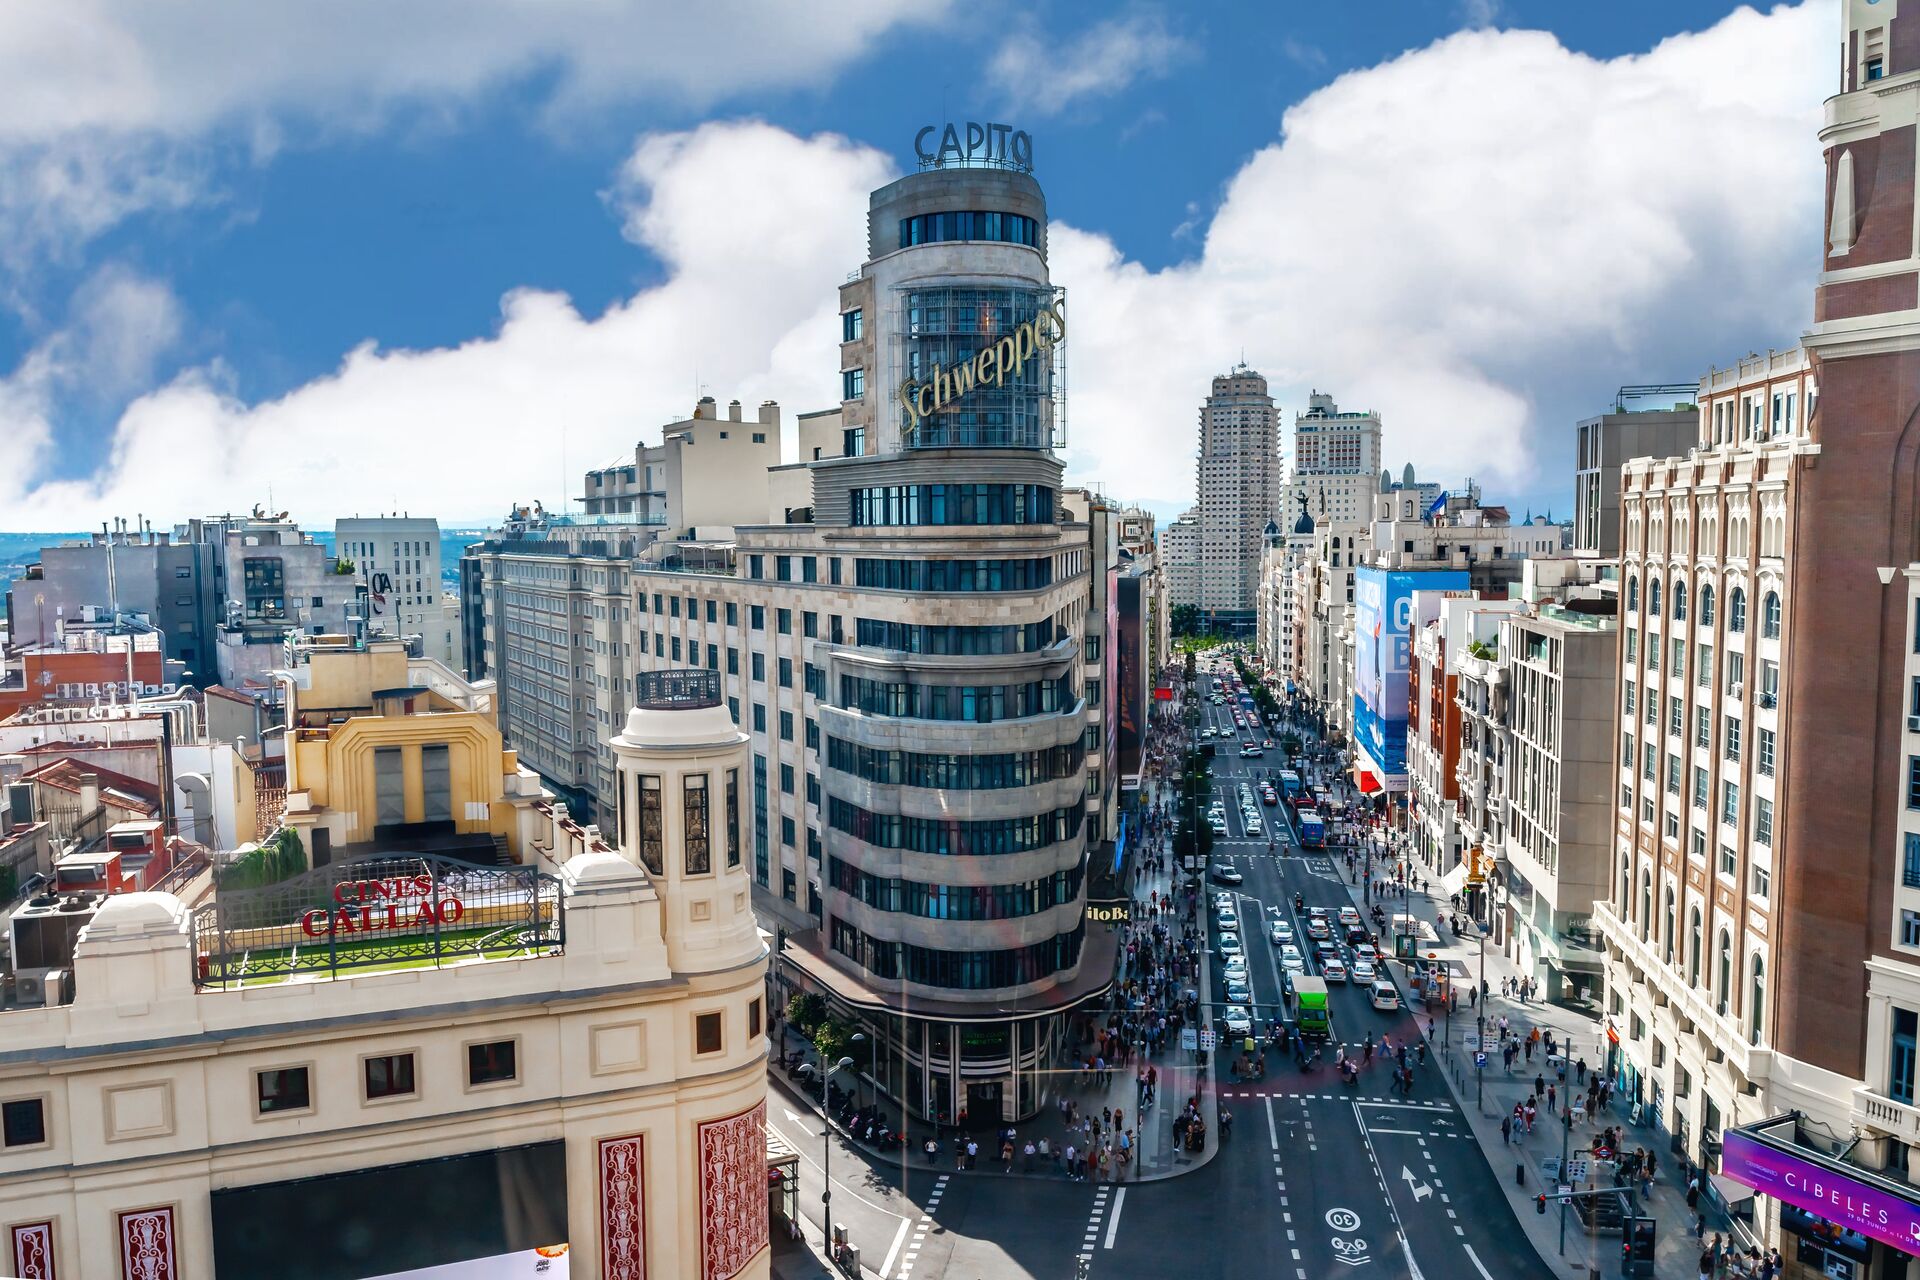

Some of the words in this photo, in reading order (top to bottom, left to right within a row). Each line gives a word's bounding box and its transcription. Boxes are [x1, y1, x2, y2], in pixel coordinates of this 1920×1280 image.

[900, 298, 1066, 434] Schweppes
[333, 874, 433, 903] CINES
[301, 896, 464, 937] CALLAO
[1477, 1053, 1486, 1063] P
[1785, 1172, 1888, 1224] CIBELES
[1856, 1216, 1864, 1224] DE
[1867, 1220, 1887, 1232] JUNIO
